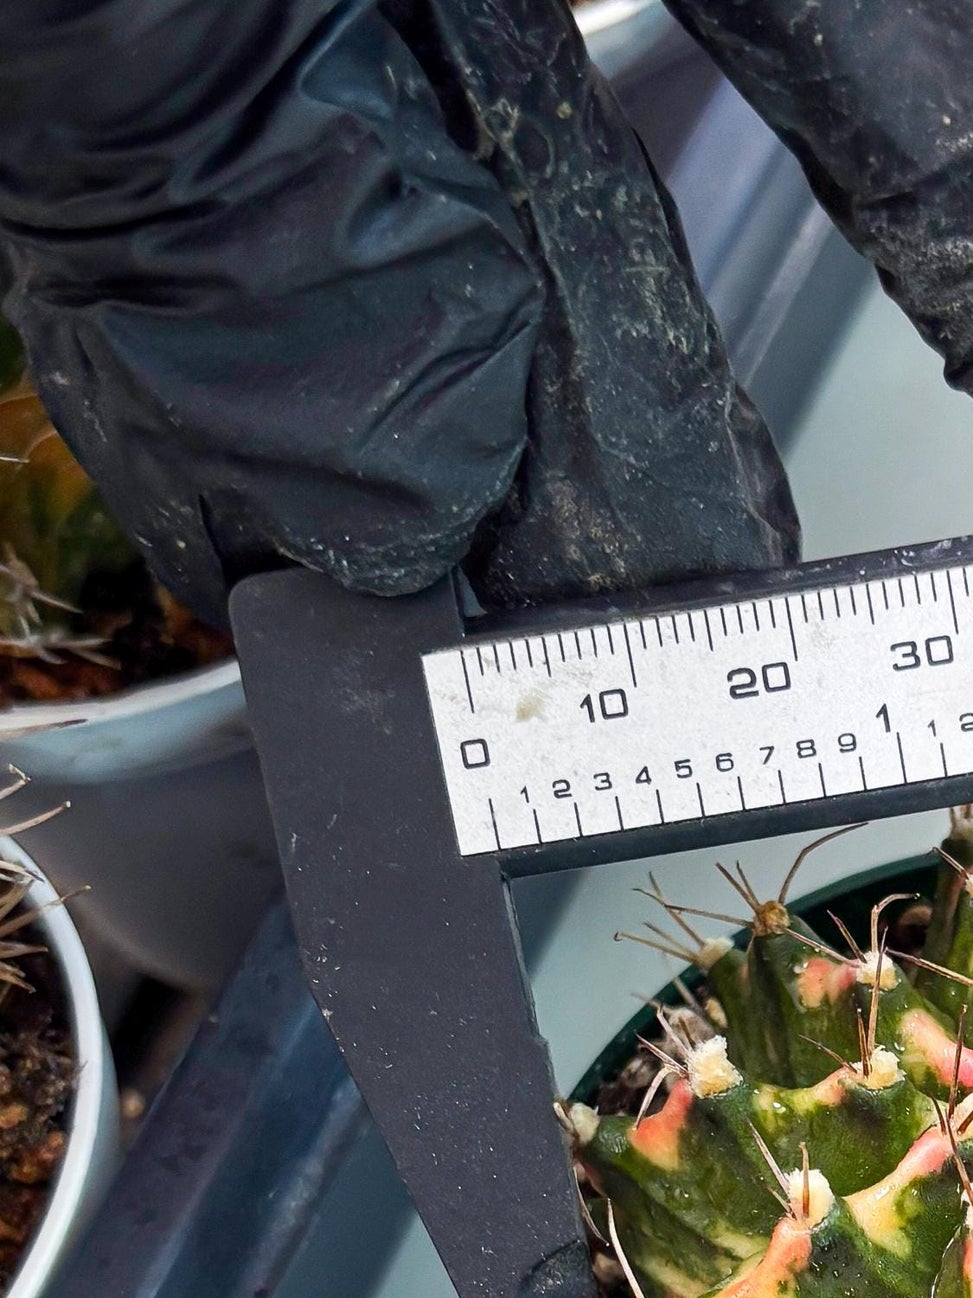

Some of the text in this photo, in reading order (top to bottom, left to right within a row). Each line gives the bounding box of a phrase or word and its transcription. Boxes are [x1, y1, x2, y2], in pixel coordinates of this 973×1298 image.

[459, 738, 491, 770] 0
[579, 688, 629, 723] 10
[726, 661, 792, 700] 20
[890, 635, 954, 672] 30
[520, 785, 530, 804] 1
[551, 779, 573, 799] 2
[593, 772, 613, 791] 3
[635, 765, 652, 785] 4
[673, 758, 693, 779] 5
[715, 752, 735, 773] 6
[759, 745, 775, 765] 7
[795, 738, 817, 759] 8
[837, 732, 857, 754] 9
[875, 703, 891, 733] 1
[927, 719, 938, 737] 1
